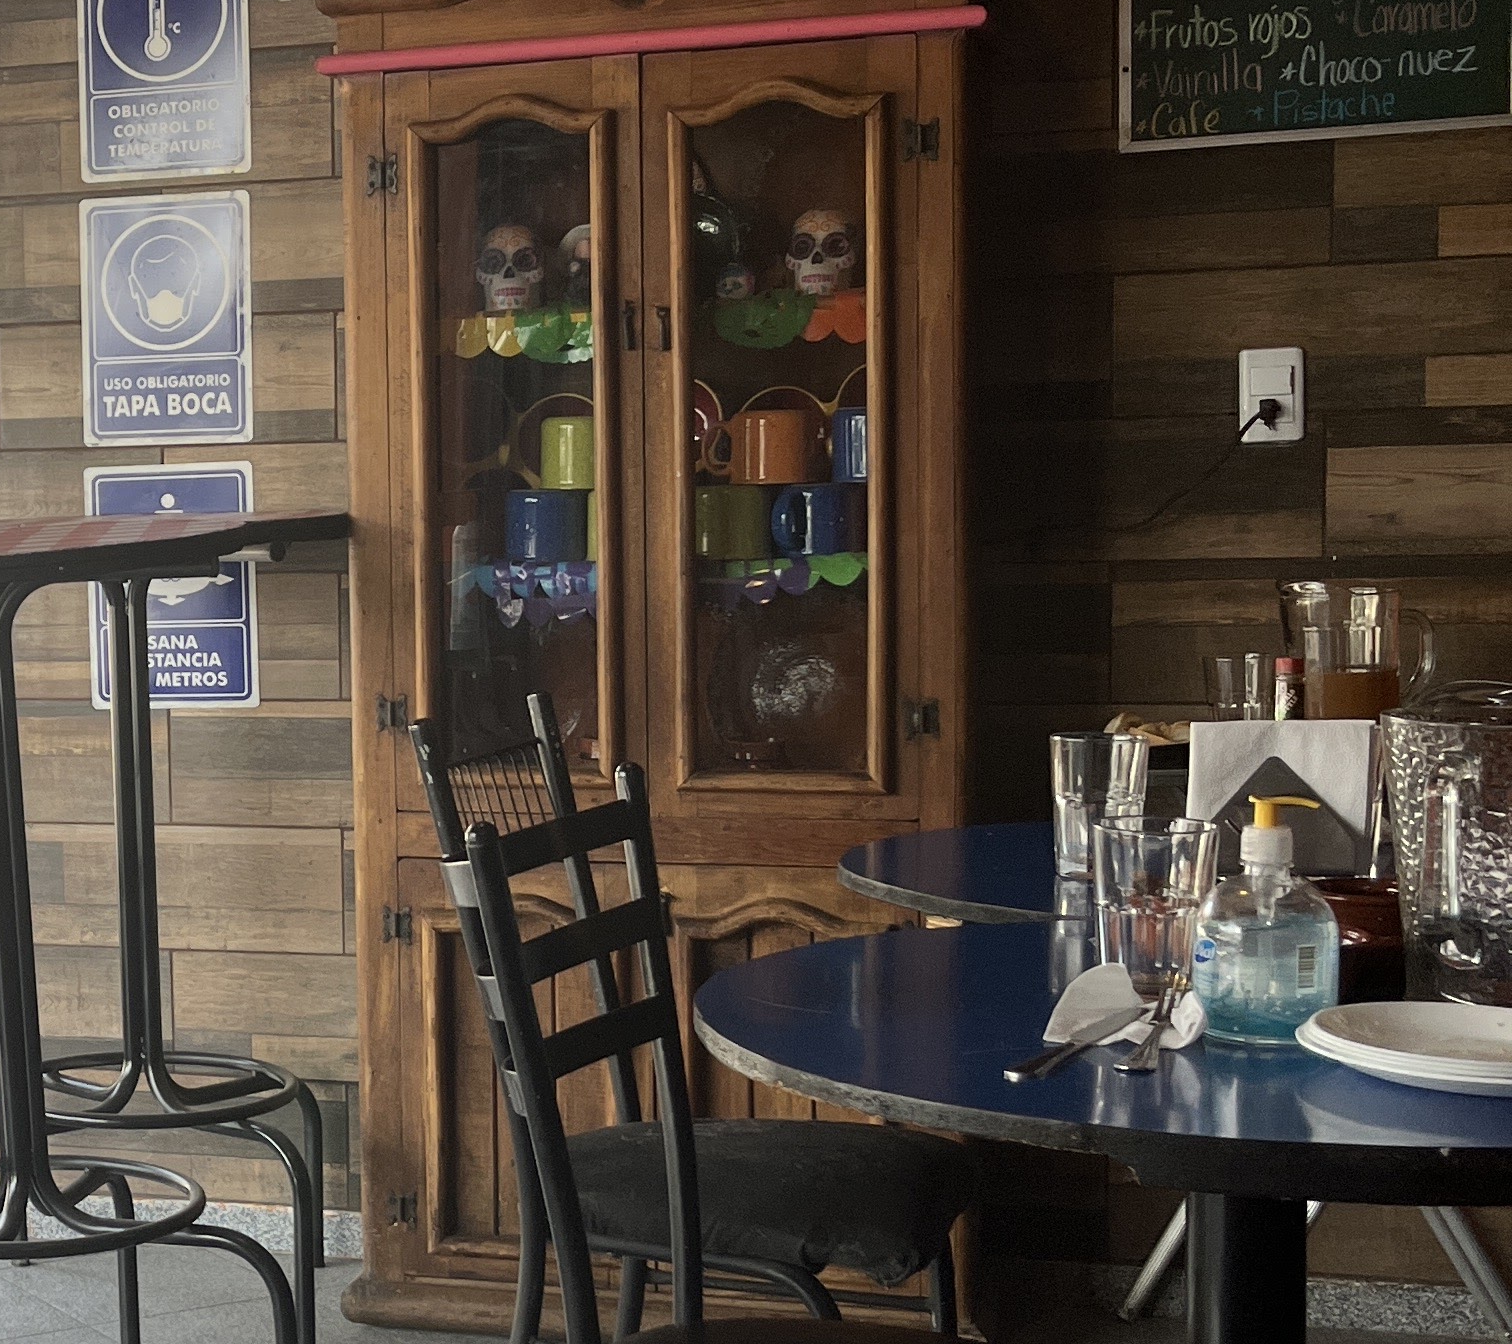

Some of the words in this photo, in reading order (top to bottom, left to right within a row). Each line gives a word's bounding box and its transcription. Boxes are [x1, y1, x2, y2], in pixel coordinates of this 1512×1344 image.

[1149, 4, 1238, 49] Frutos
[1248, 4, 1312, 58] rojos
[1152, 47, 1263, 101] Vainilla
[107, 97, 220, 120] OBLIGATORIO
[1272, 85, 1397, 126] Pistache
[113, 119, 190, 139] CONTROL
[196, 118, 216, 132] DE
[108, 136, 222, 158] TEMPERATURA
[103, 376, 133, 391] USO
[136, 373, 231, 390] OBLIGATORIO
[103, 394, 161, 418] TAPA
[167, 391, 233, 417] BOCA
[147, 634, 199, 650] SANA
[147, 651, 222, 668] STANCIA
[155, 671, 228, 688] METROS
